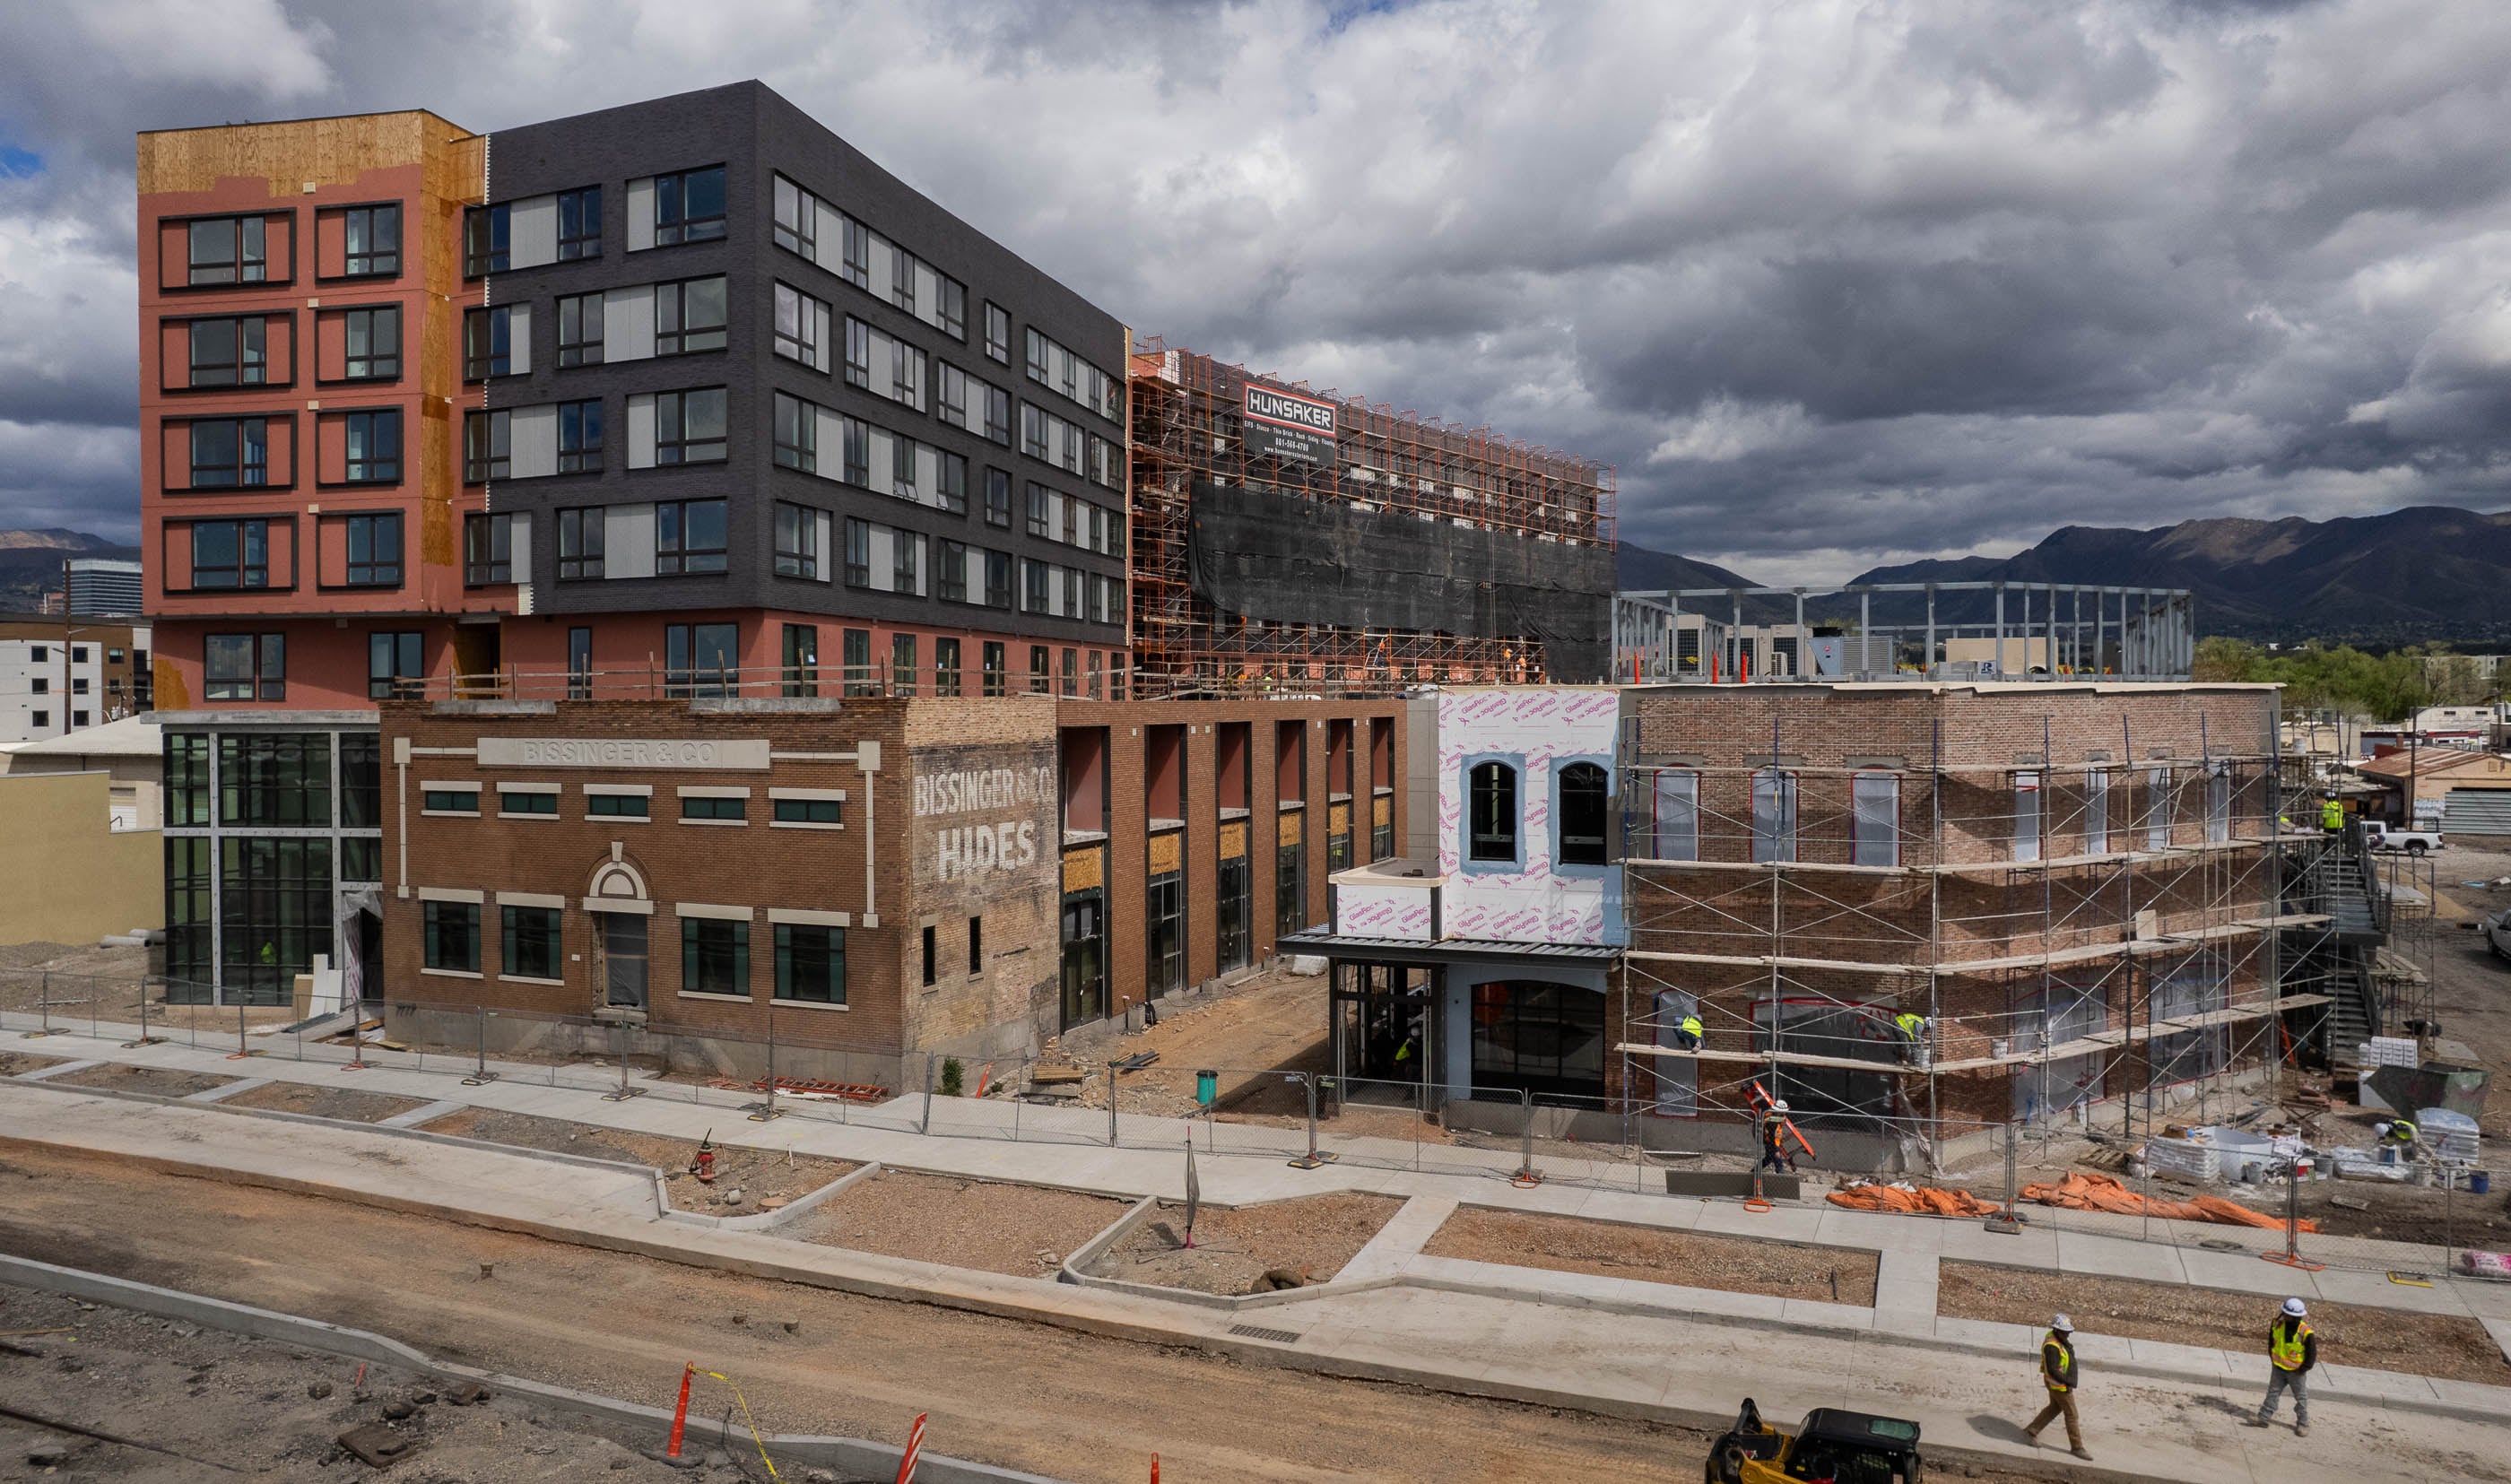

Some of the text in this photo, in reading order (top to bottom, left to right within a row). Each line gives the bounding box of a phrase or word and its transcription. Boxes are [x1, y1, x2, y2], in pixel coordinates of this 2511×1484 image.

[1249, 393, 1332, 427] HUNSAKER
[1282, 429, 1293, 437] Brick
[1462, 696, 1488, 714] GlasRoc
[1480, 698, 1507, 716] GlasRoc
[1529, 698, 1556, 715] GlasRoc
[1565, 695, 1593, 712] GlasRoc
[524, 741, 715, 764] BISSINGER & CO
[915, 768, 1016, 817] BISSINGER
[1017, 770, 1028, 803] &
[938, 820, 1036, 882] HIDES
[1349, 904, 1375, 921] GlasRoc
[1367, 907, 1393, 924] GlasRoc
[1402, 907, 1428, 924] GlasRoc
[1493, 913, 1520, 929] GlasRoc
[1512, 916, 1539, 932] GlasRoc
